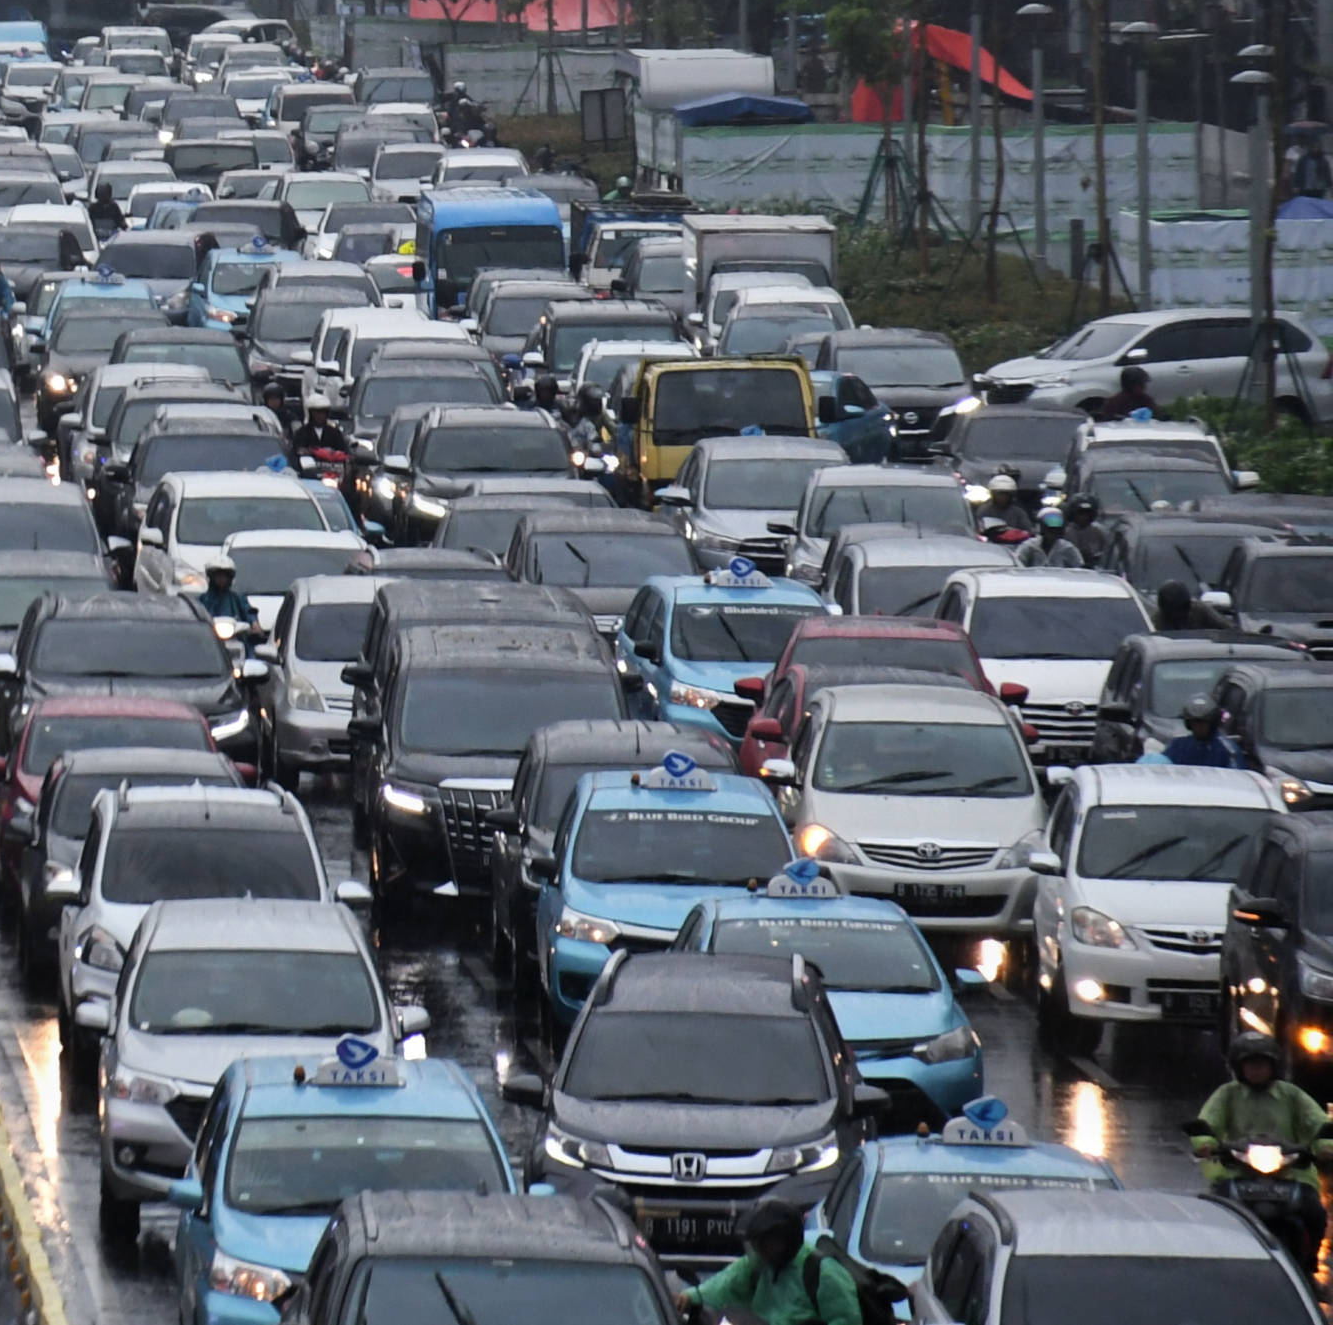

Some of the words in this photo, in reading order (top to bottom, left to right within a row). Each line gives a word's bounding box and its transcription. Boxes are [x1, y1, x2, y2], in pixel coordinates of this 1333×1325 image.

[779, 884, 827, 895] TAKSI
[331, 1070, 386, 1083] TAKSI
[957, 1129, 1014, 1142] TAKSI
